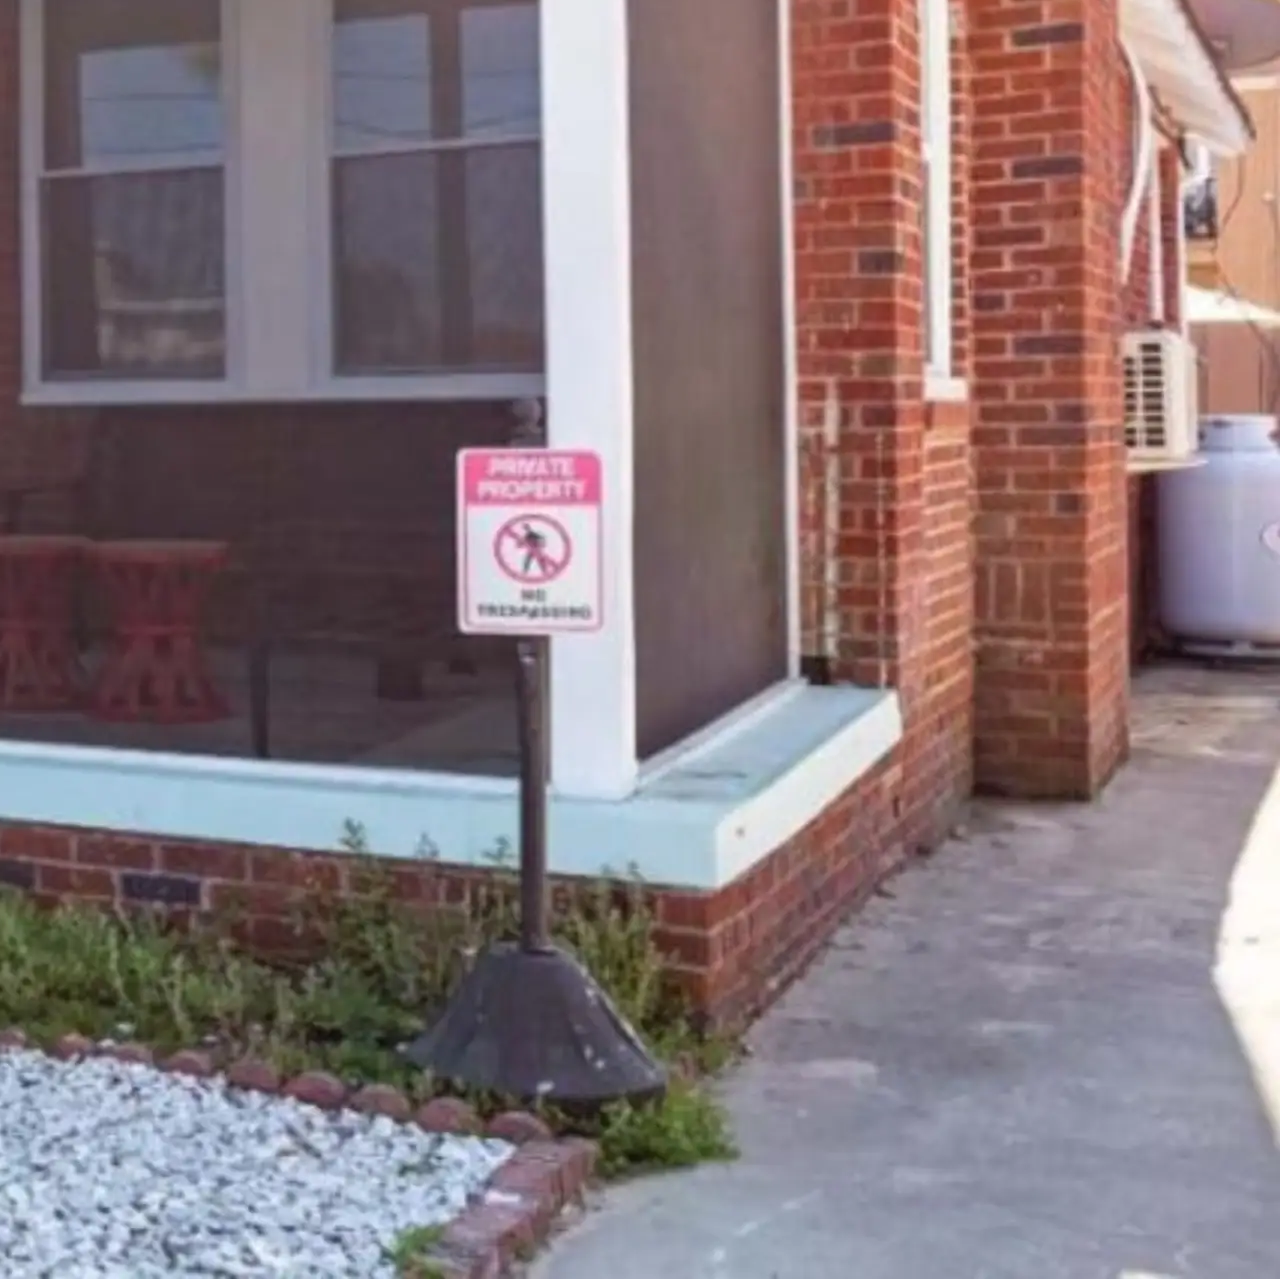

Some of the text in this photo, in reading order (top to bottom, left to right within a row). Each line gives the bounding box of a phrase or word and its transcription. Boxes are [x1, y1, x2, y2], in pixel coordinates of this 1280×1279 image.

[486, 456, 574, 477] PRIVATE
[476, 479, 586, 500] PROPERTY
[520, 589, 547, 602] NO
[477, 604, 592, 619] TRESPASSING
